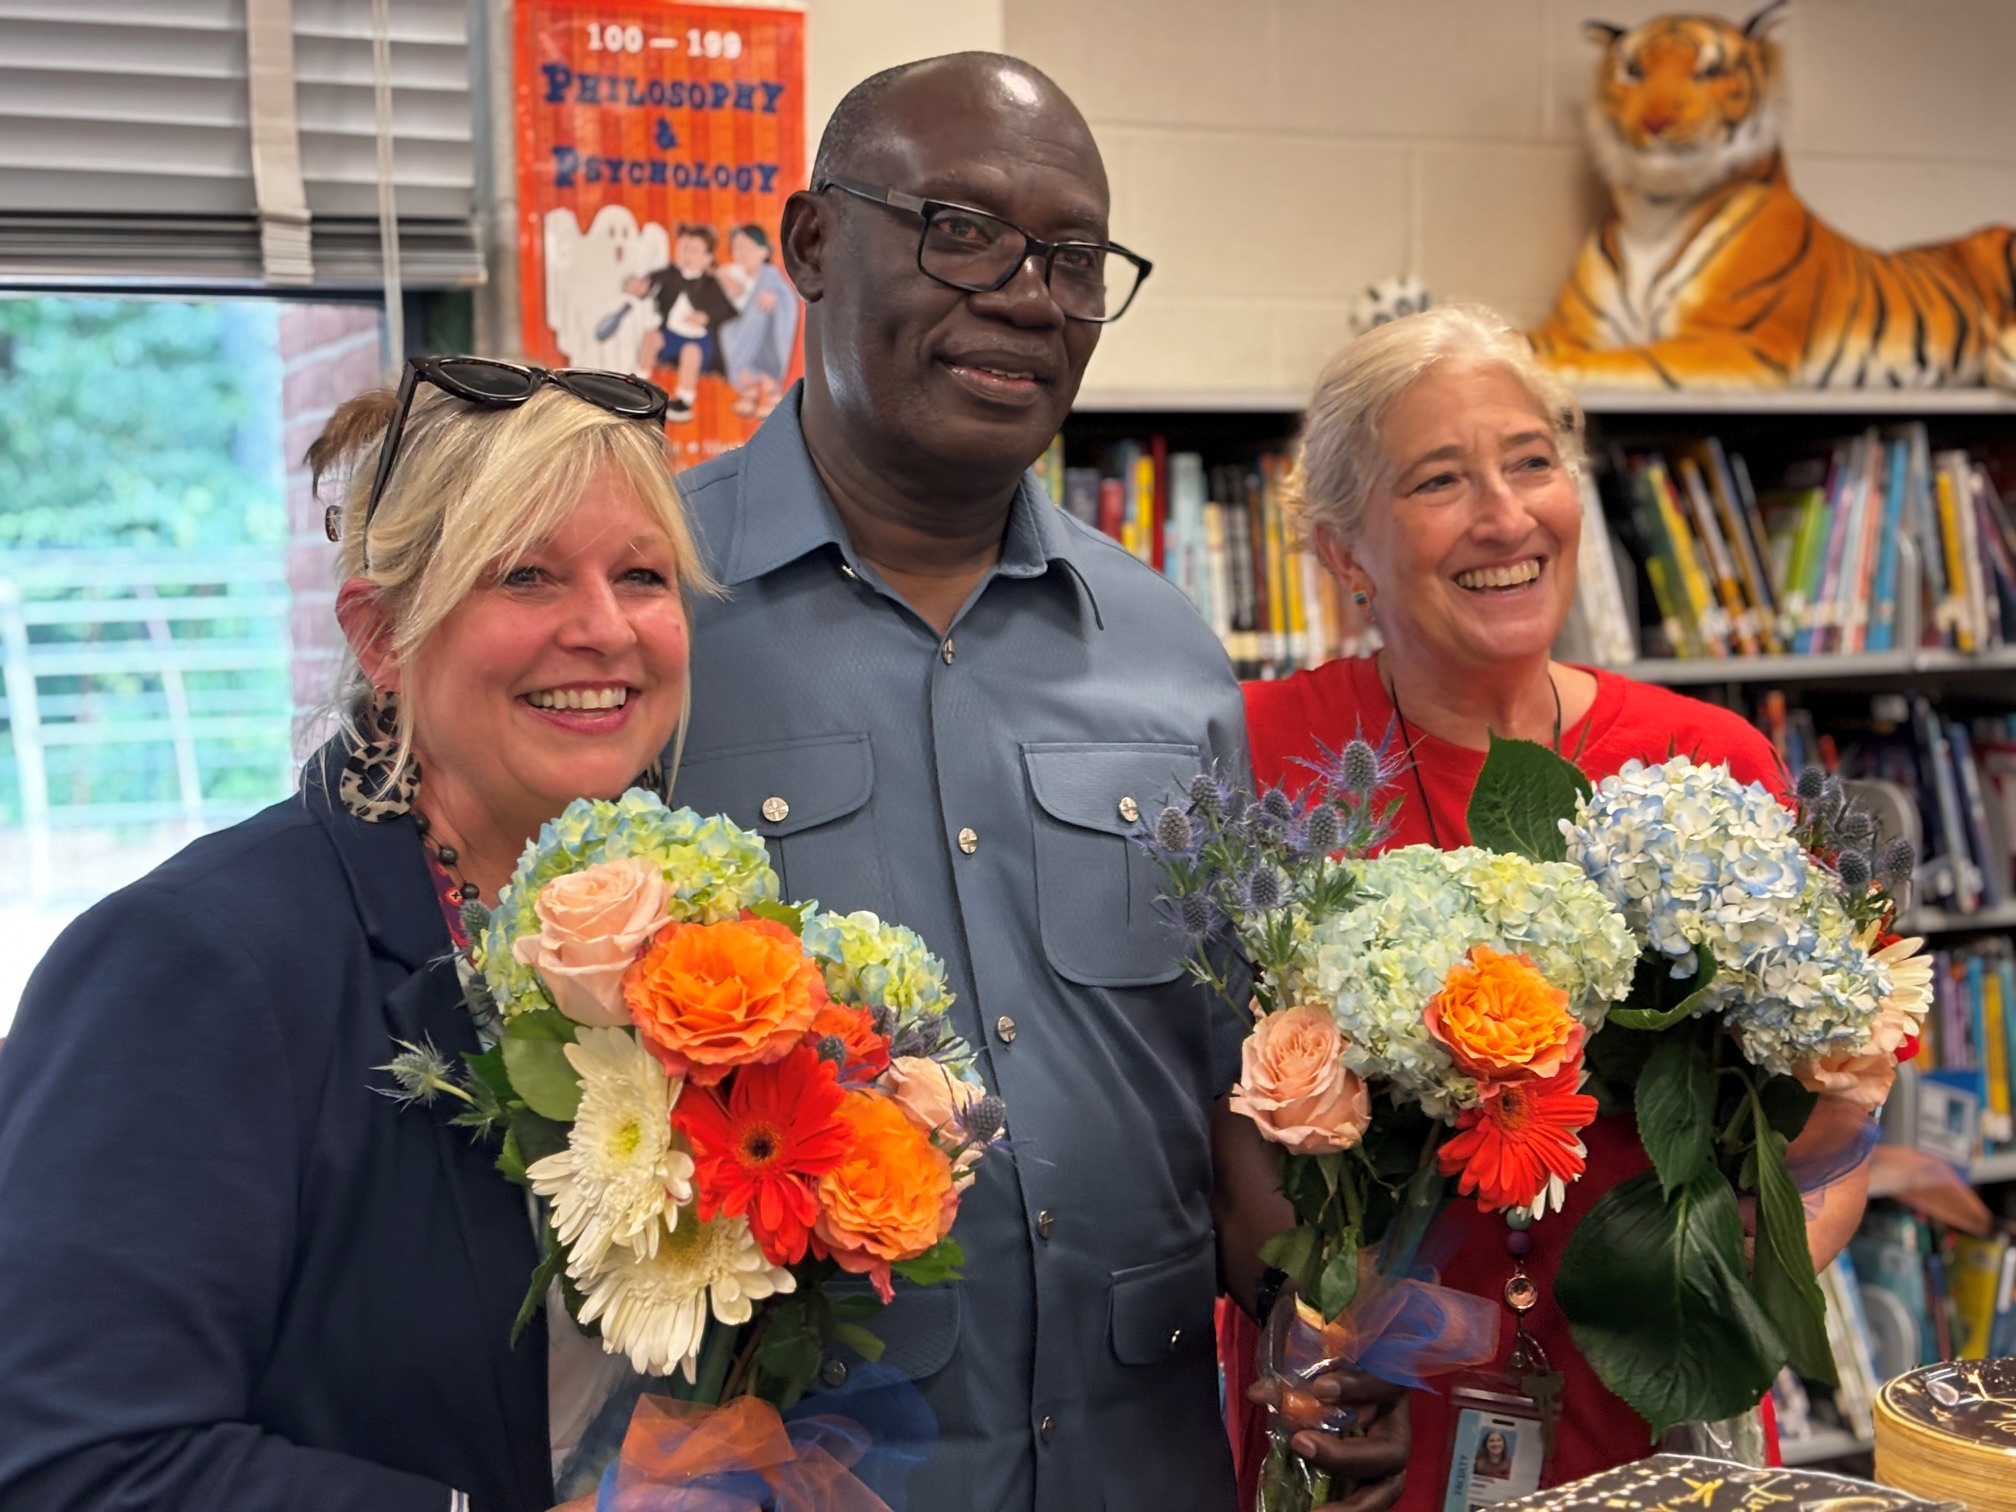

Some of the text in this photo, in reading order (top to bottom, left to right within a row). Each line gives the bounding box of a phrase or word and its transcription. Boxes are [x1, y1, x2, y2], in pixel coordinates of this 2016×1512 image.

[587, 22, 644, 54] 100
[686, 28, 743, 60] 199
[541, 62, 784, 113] PHILOSOPHY
[656, 118, 677, 149] &
[551, 145, 780, 193] PSYCHOLOGY
